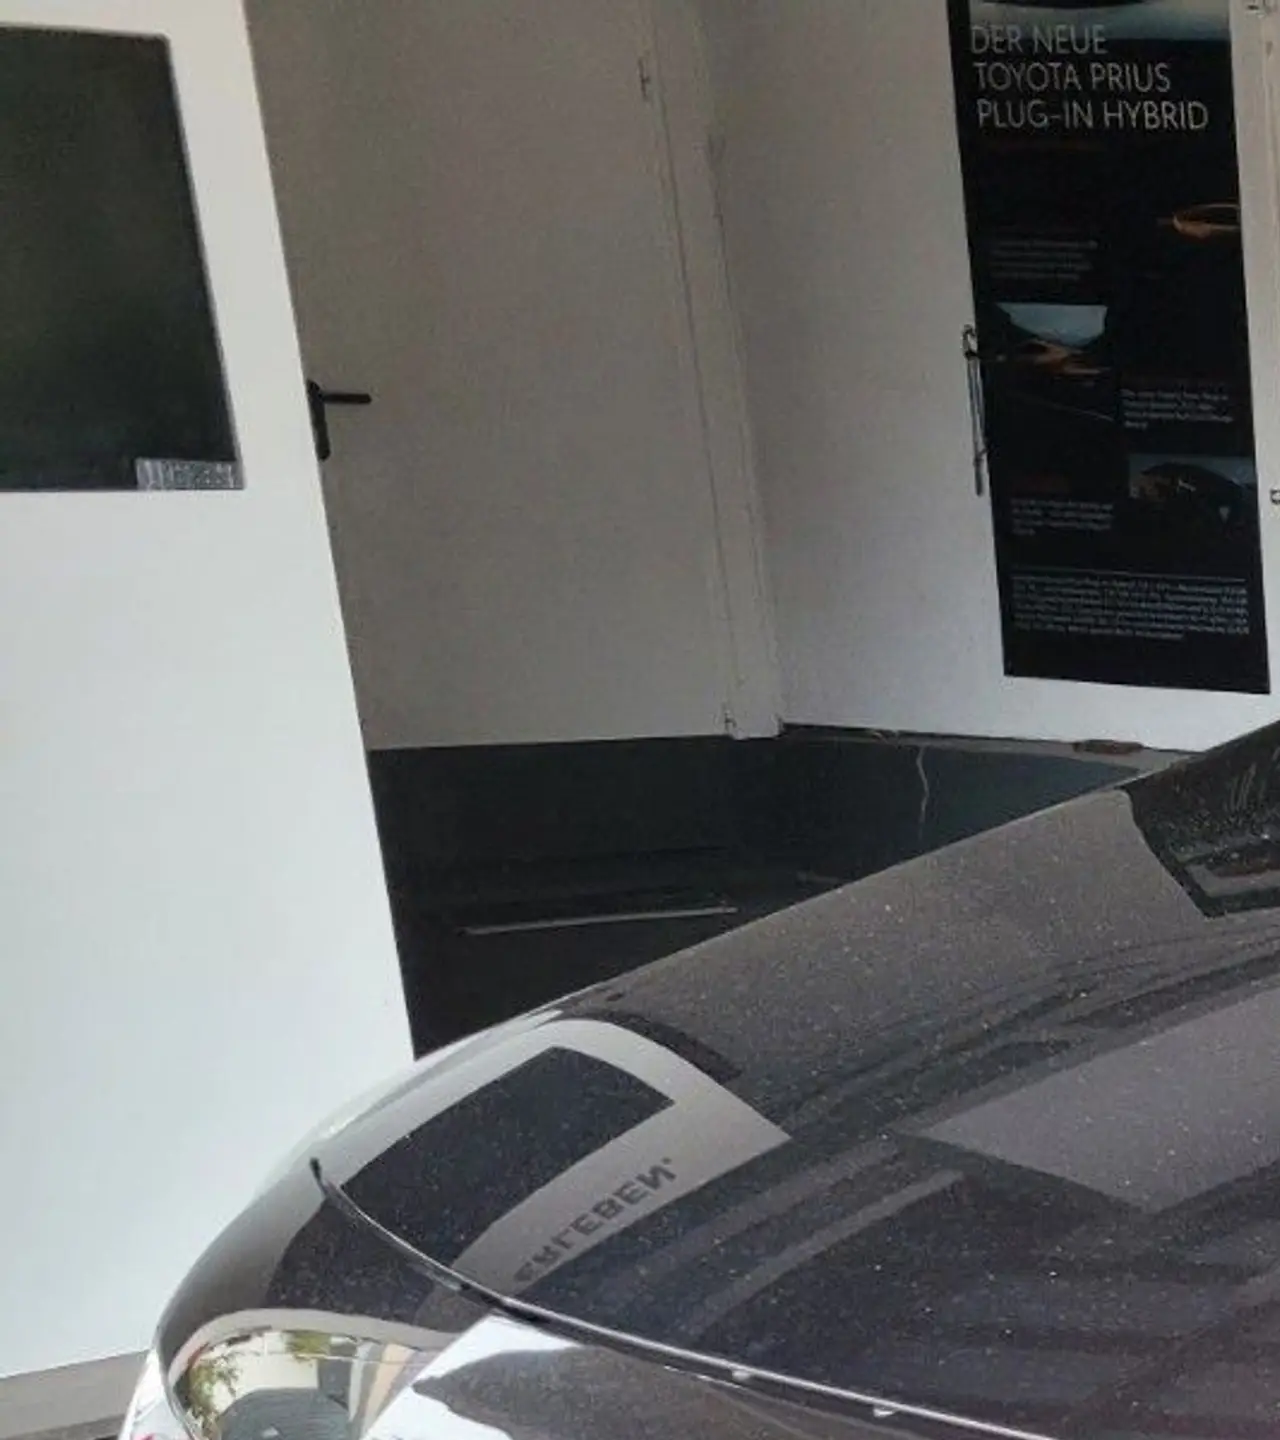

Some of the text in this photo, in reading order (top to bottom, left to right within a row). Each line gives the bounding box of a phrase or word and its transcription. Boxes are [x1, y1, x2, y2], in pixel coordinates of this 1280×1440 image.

[970, 25, 1109, 54] DER NEUE
[973, 62, 1172, 93] TOYOTA PRIUS
[976, 99, 1210, 130] PLUG-IN HYBRID
